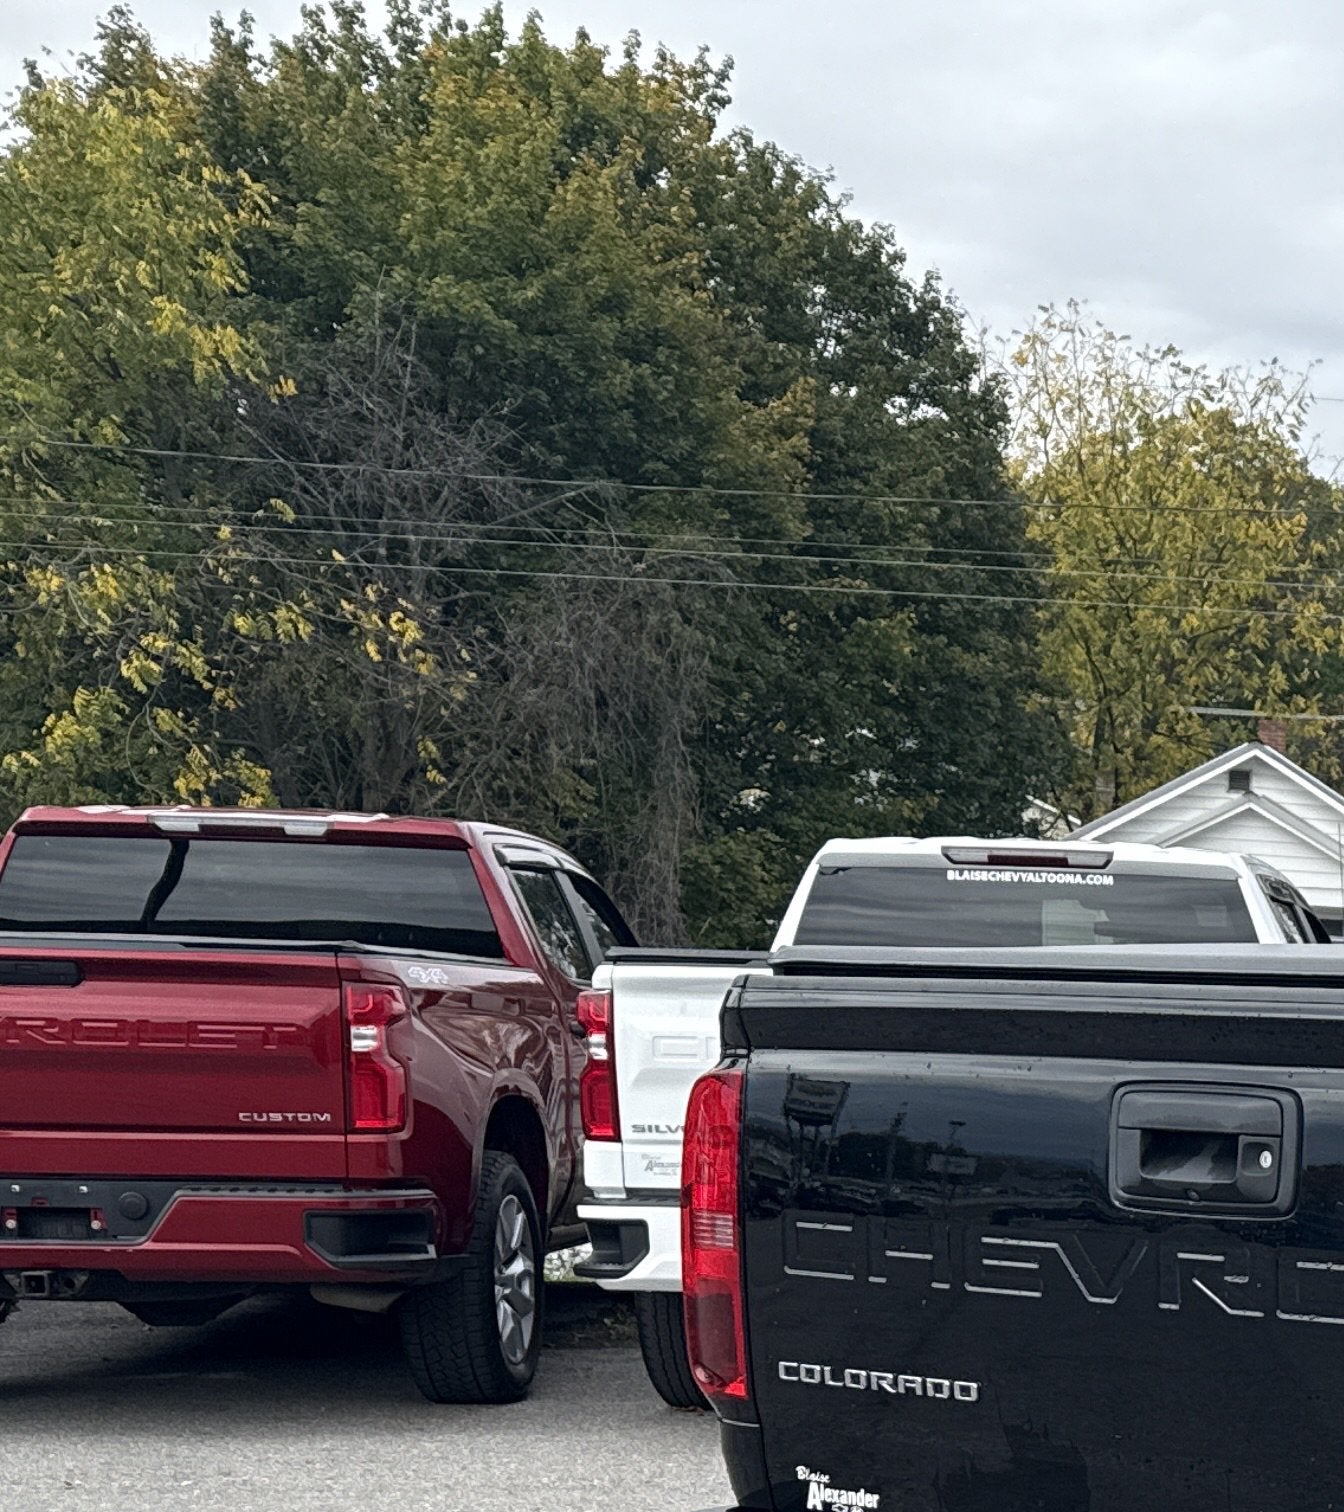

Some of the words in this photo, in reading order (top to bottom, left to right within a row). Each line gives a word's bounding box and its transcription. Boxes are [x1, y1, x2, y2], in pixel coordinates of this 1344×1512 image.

[946, 869, 1114, 886] BLAISECHEVYALTOONA.COM
[0, 1016, 298, 1050] ROLET
[238, 1111, 332, 1123] CUSTOM
[630, 1123, 684, 1135] SILV
[778, 1361, 979, 1401] COLORADO
[795, 1465, 831, 1484] Blaise
[807, 1481, 880, 1511] Alexander
